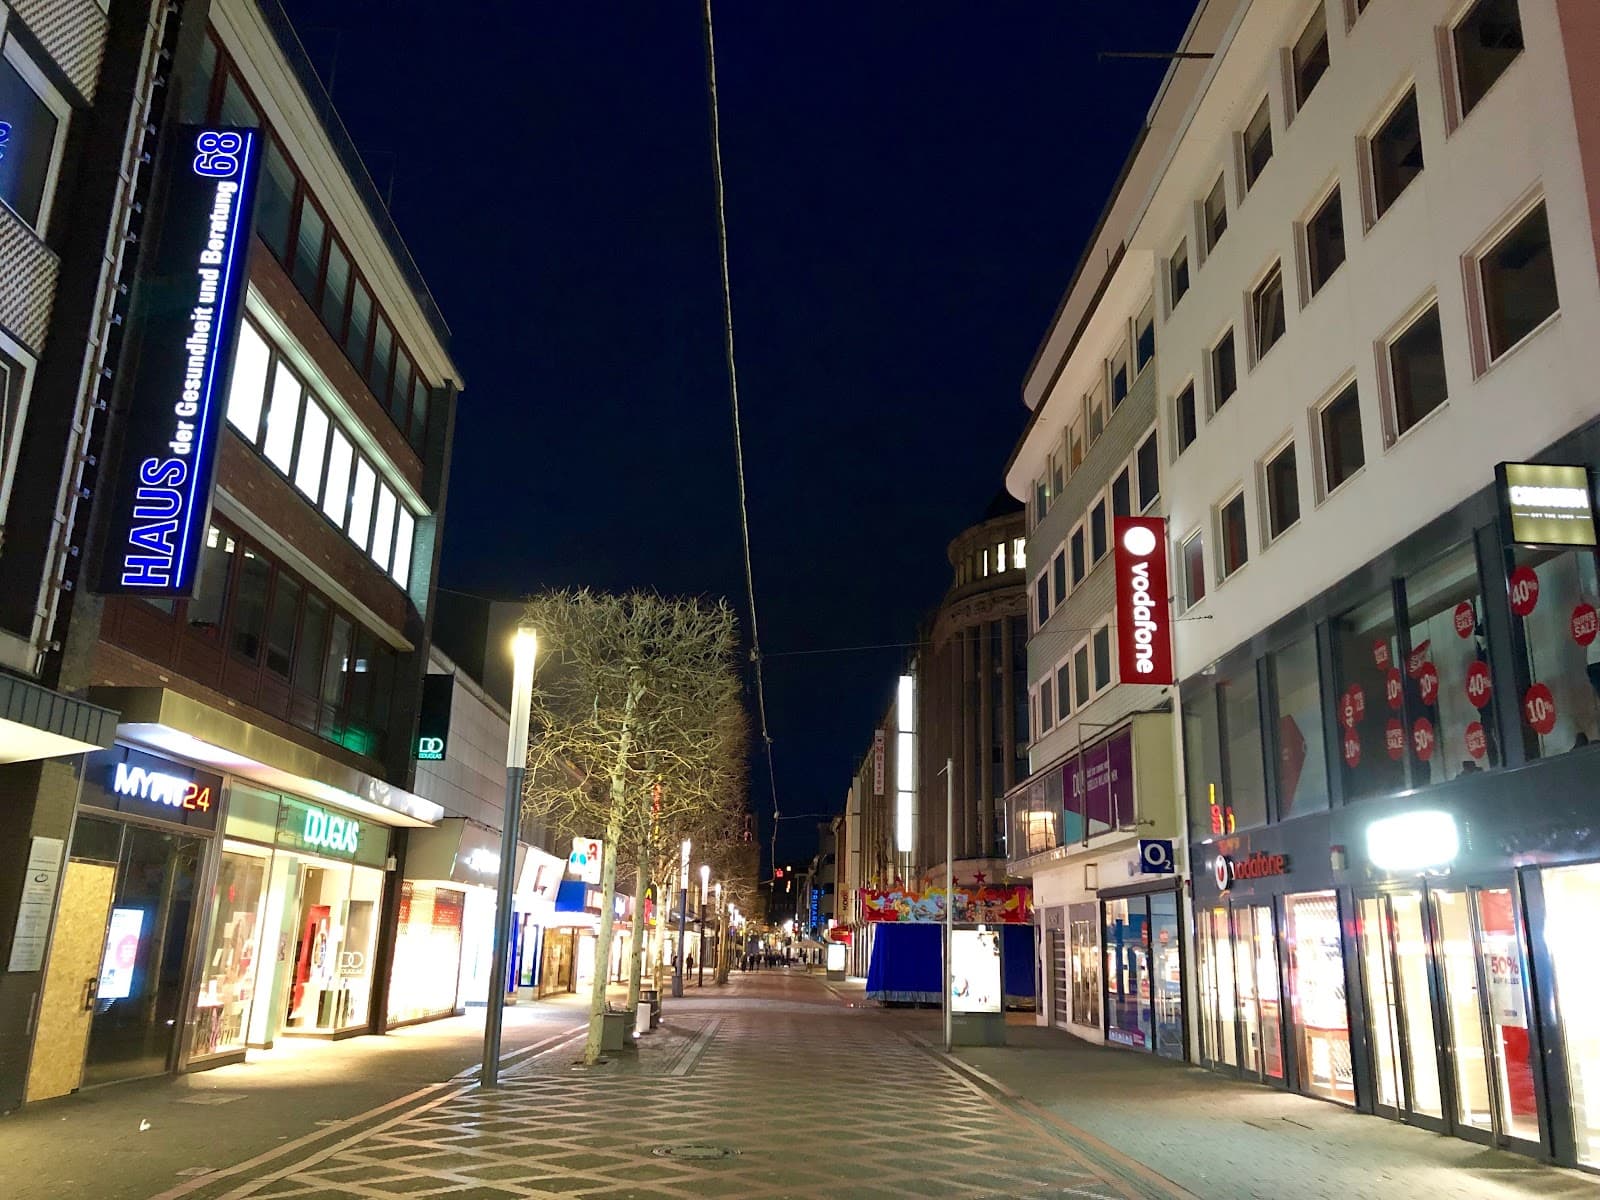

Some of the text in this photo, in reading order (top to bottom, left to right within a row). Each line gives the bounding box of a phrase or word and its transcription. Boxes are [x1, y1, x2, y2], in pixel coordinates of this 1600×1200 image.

[121, 131, 243, 588] HAUS der Gesundheit und Beratung 68
[1511, 579, 1538, 606] 40%
[1131, 561, 1155, 675] vodafone
[1574, 620, 1597, 639] SALE
[1468, 674, 1493, 697] 40%
[1527, 697, 1554, 724] 10%
[418, 752, 443, 760] DOUGLAS
[303, 808, 360, 854] DOUGLAS
[1228, 850, 1284, 882] vodafone
[810, 889, 819, 928] PRIMARK
[1491, 955, 1519, 975] 50%
